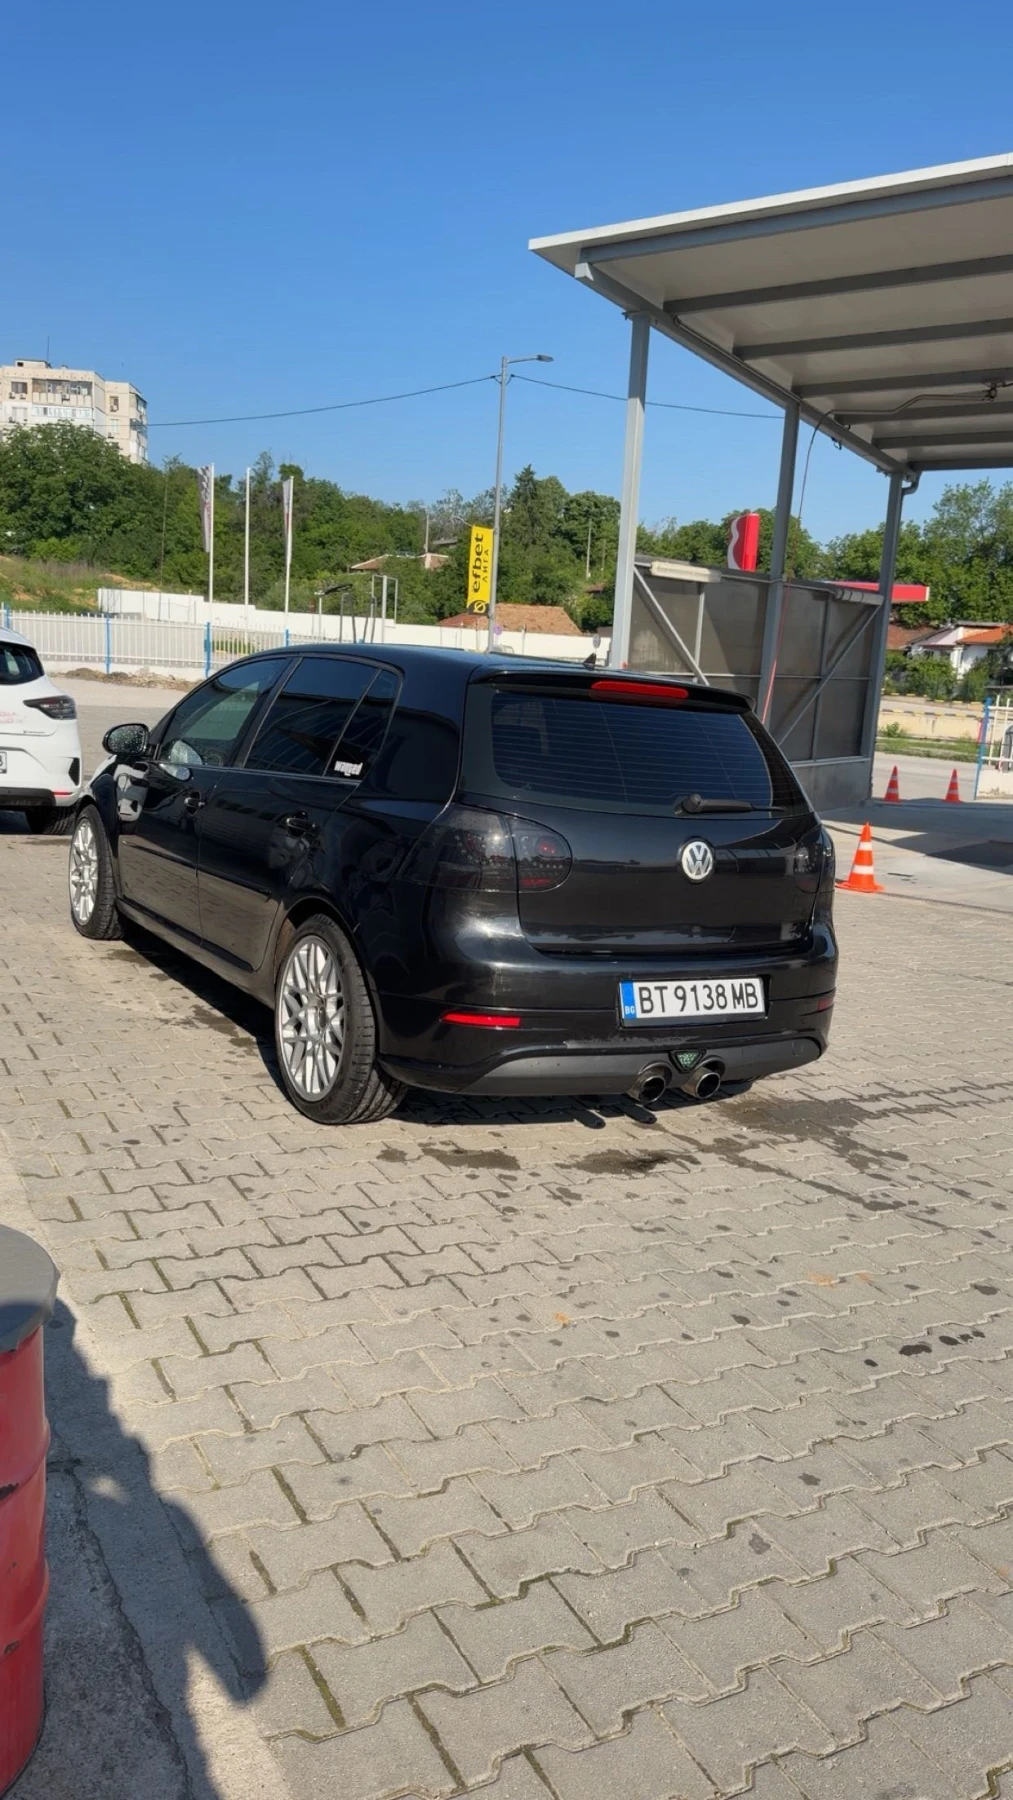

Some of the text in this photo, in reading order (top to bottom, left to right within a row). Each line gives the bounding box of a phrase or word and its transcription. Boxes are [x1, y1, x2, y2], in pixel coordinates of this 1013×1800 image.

[472, 533, 484, 593] efbet
[482, 549, 490, 583] ЛИГА
[624, 1006, 635, 1014] BG
[638, 982, 759, 1014] BT 9138 MB
